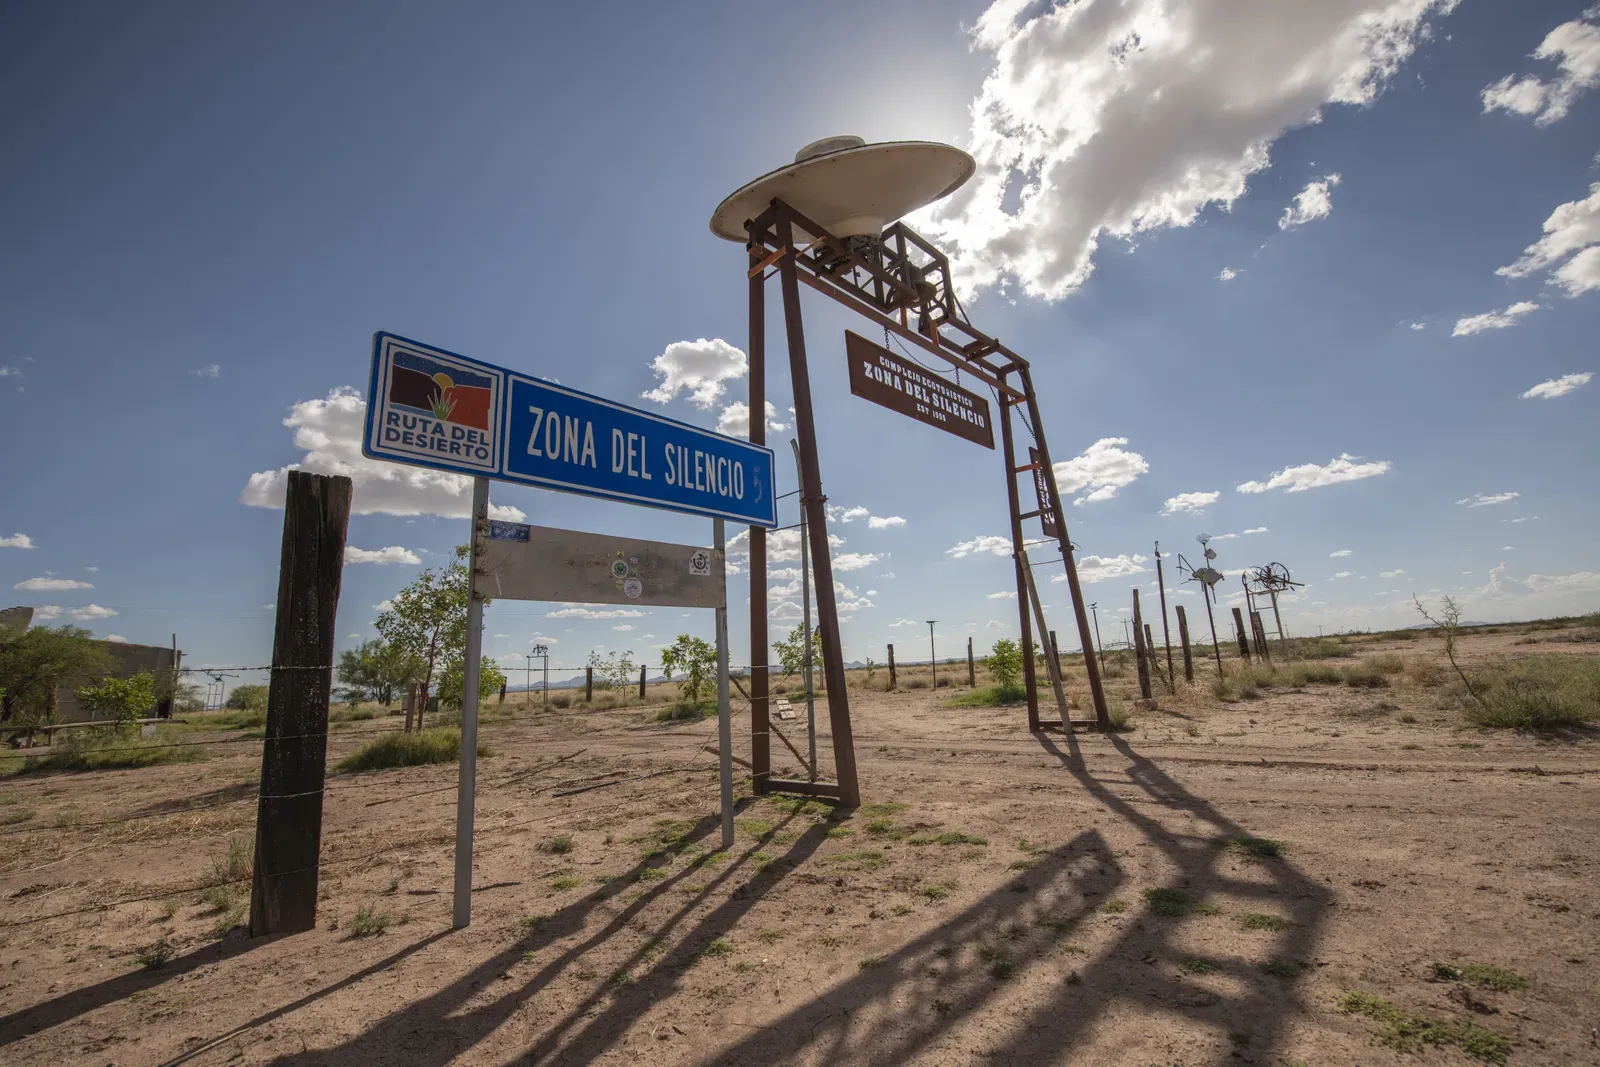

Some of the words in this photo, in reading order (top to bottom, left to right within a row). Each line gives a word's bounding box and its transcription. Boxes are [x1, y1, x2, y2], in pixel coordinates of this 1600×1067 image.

[864, 361, 902, 391] ZONA
[904, 380, 930, 404] DEL
[931, 392, 985, 428] SILENCIO
[916, 403, 929, 415] EST
[385, 428, 489, 460] DESIERTO
[387, 411, 445, 437] RUTA
[452, 426, 490, 446] DEL
[527, 405, 597, 468] ZONA
[612, 428, 652, 480] DEL
[664, 442, 744, 500] SILENCIO
